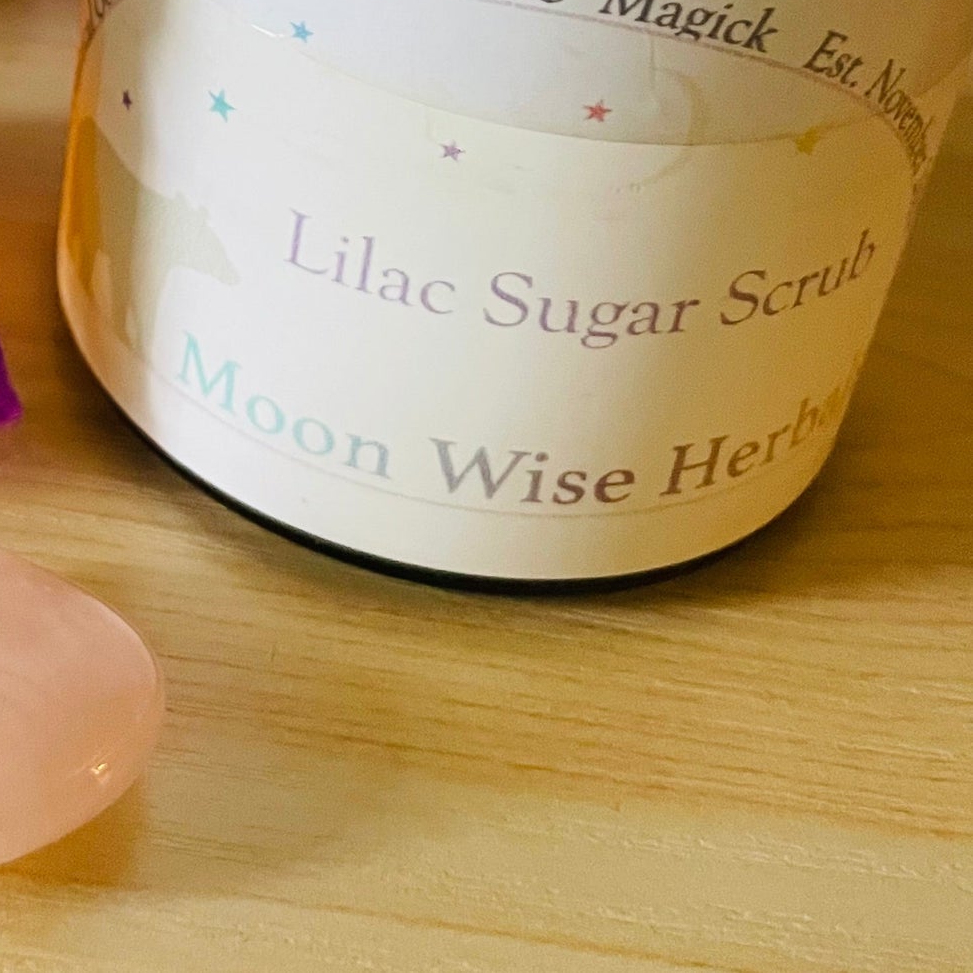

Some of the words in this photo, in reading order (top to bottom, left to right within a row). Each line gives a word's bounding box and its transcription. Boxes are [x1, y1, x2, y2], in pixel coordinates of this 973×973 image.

[802, 29, 864, 88] Est.
[283, 208, 457, 317] Lilac
[482, 271, 701, 350] Sugar
[718, 229, 877, 327] Scrub
[175, 329, 393, 481] Moon
[428, 436, 636, 507] Wise
